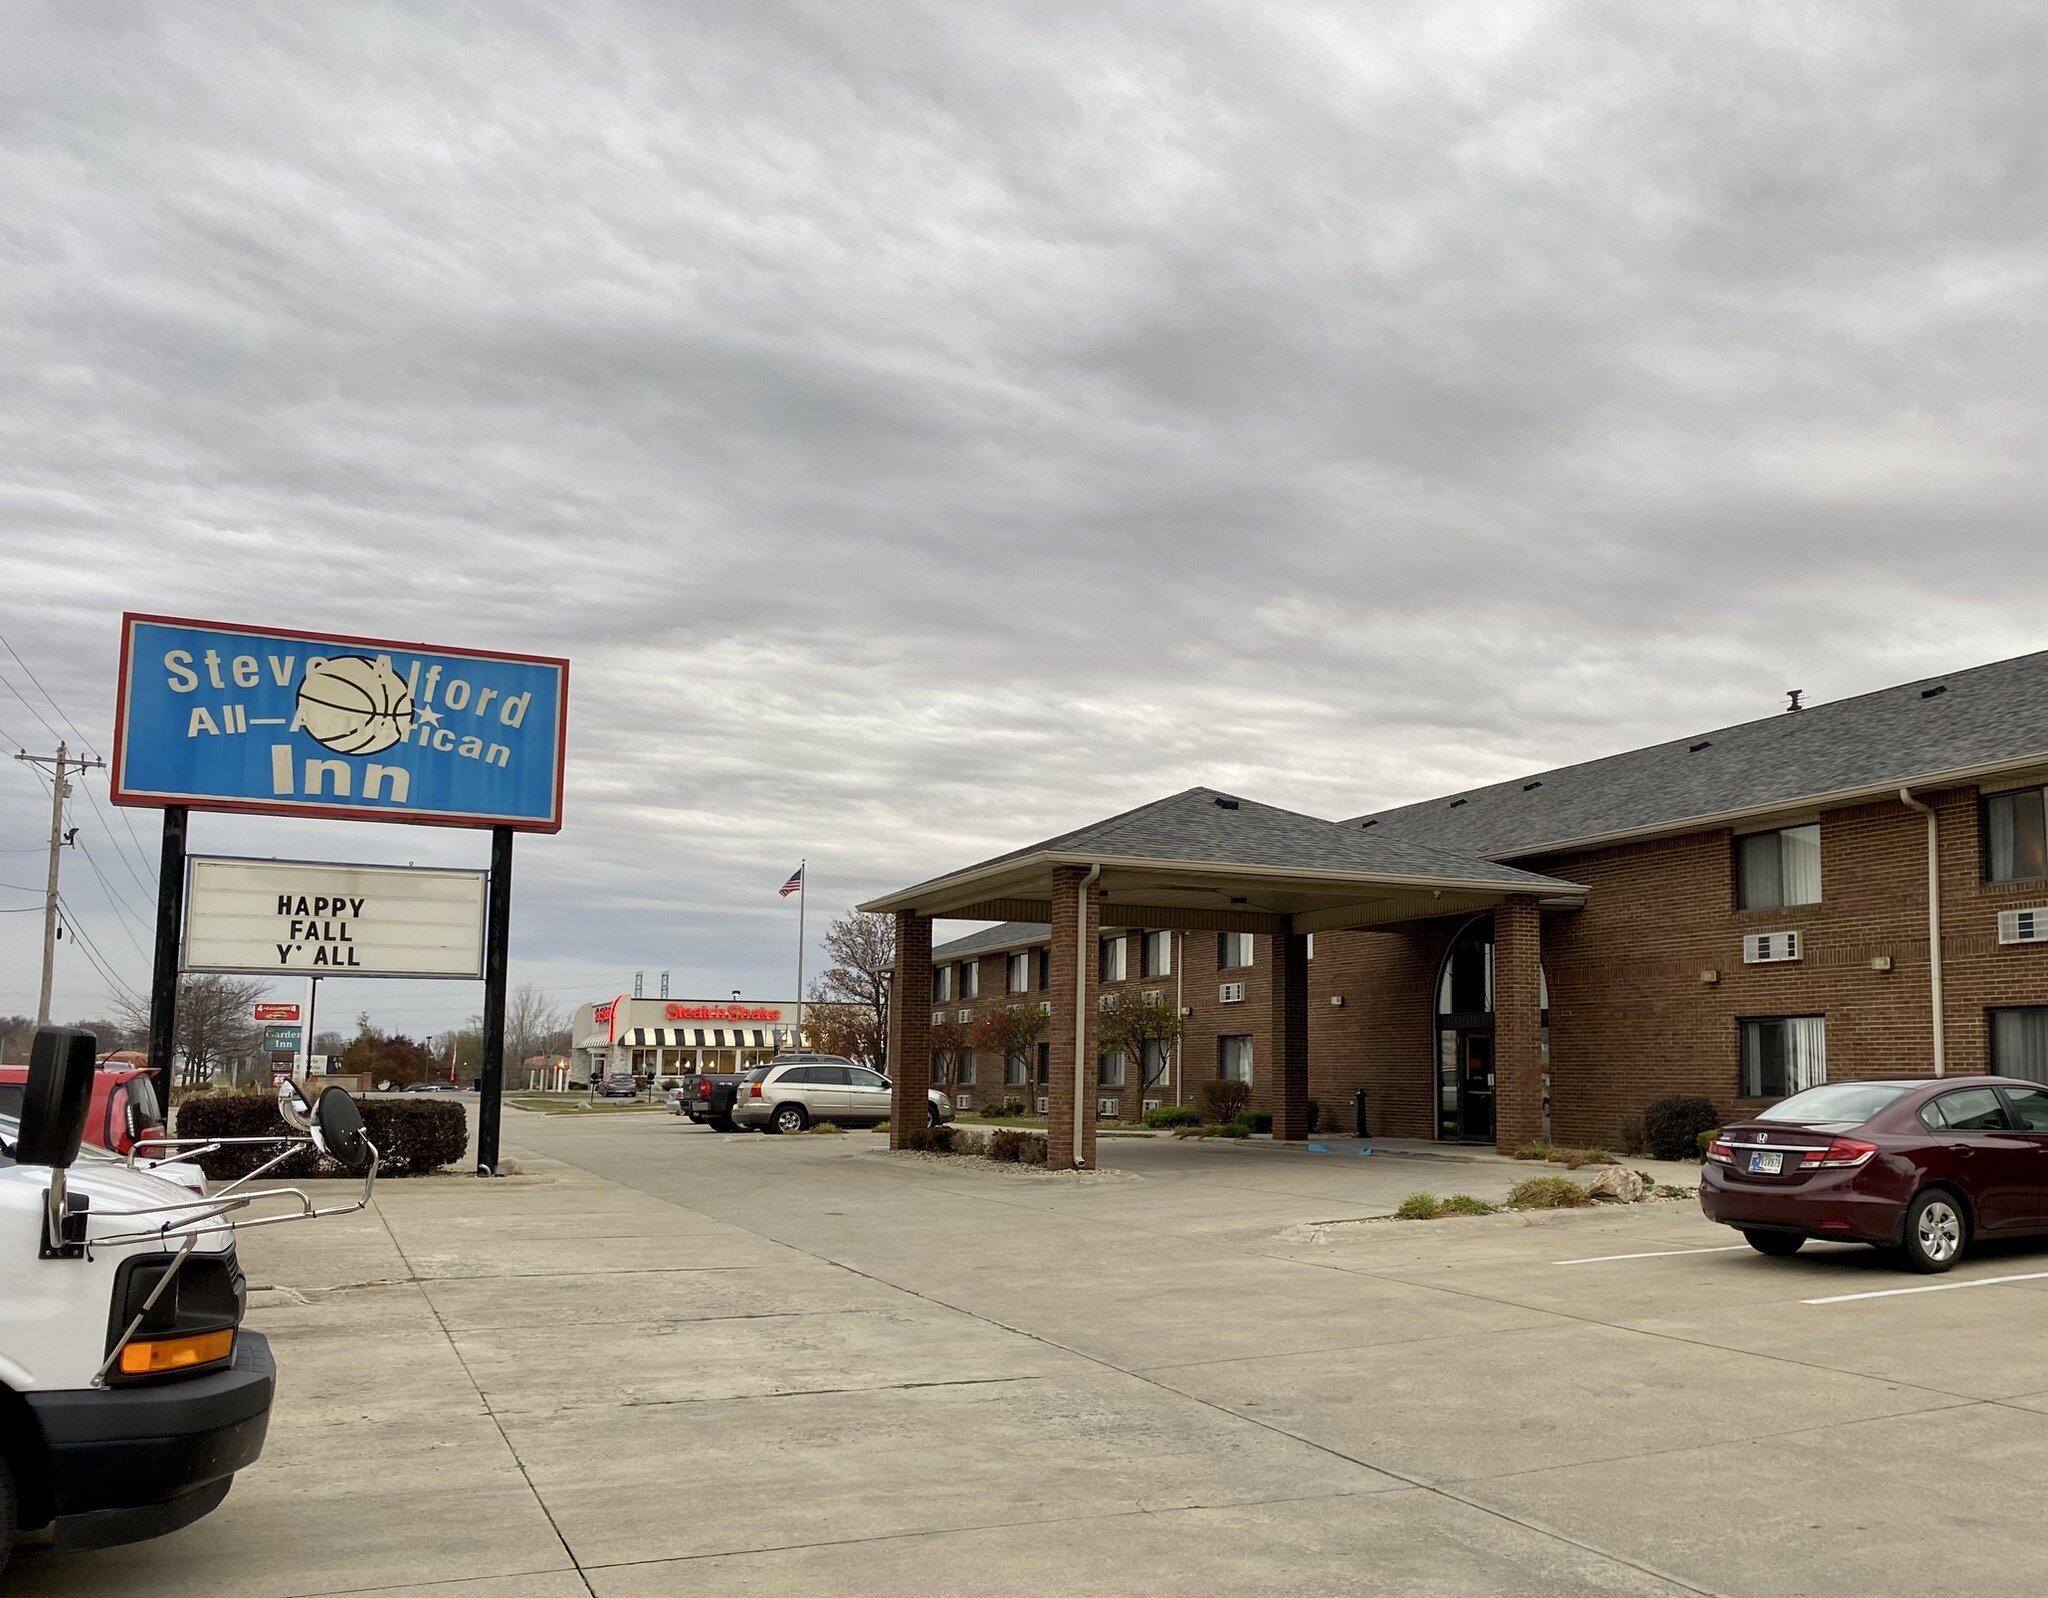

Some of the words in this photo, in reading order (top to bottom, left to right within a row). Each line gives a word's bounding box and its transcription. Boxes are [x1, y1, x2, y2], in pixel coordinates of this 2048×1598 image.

[187, 703, 512, 768] All-Arican
[270, 744, 412, 803] Inn
[277, 895, 365, 918] HAPPY
[290, 920, 353, 942] FALL
[275, 1040, 293, 1048] Inn
